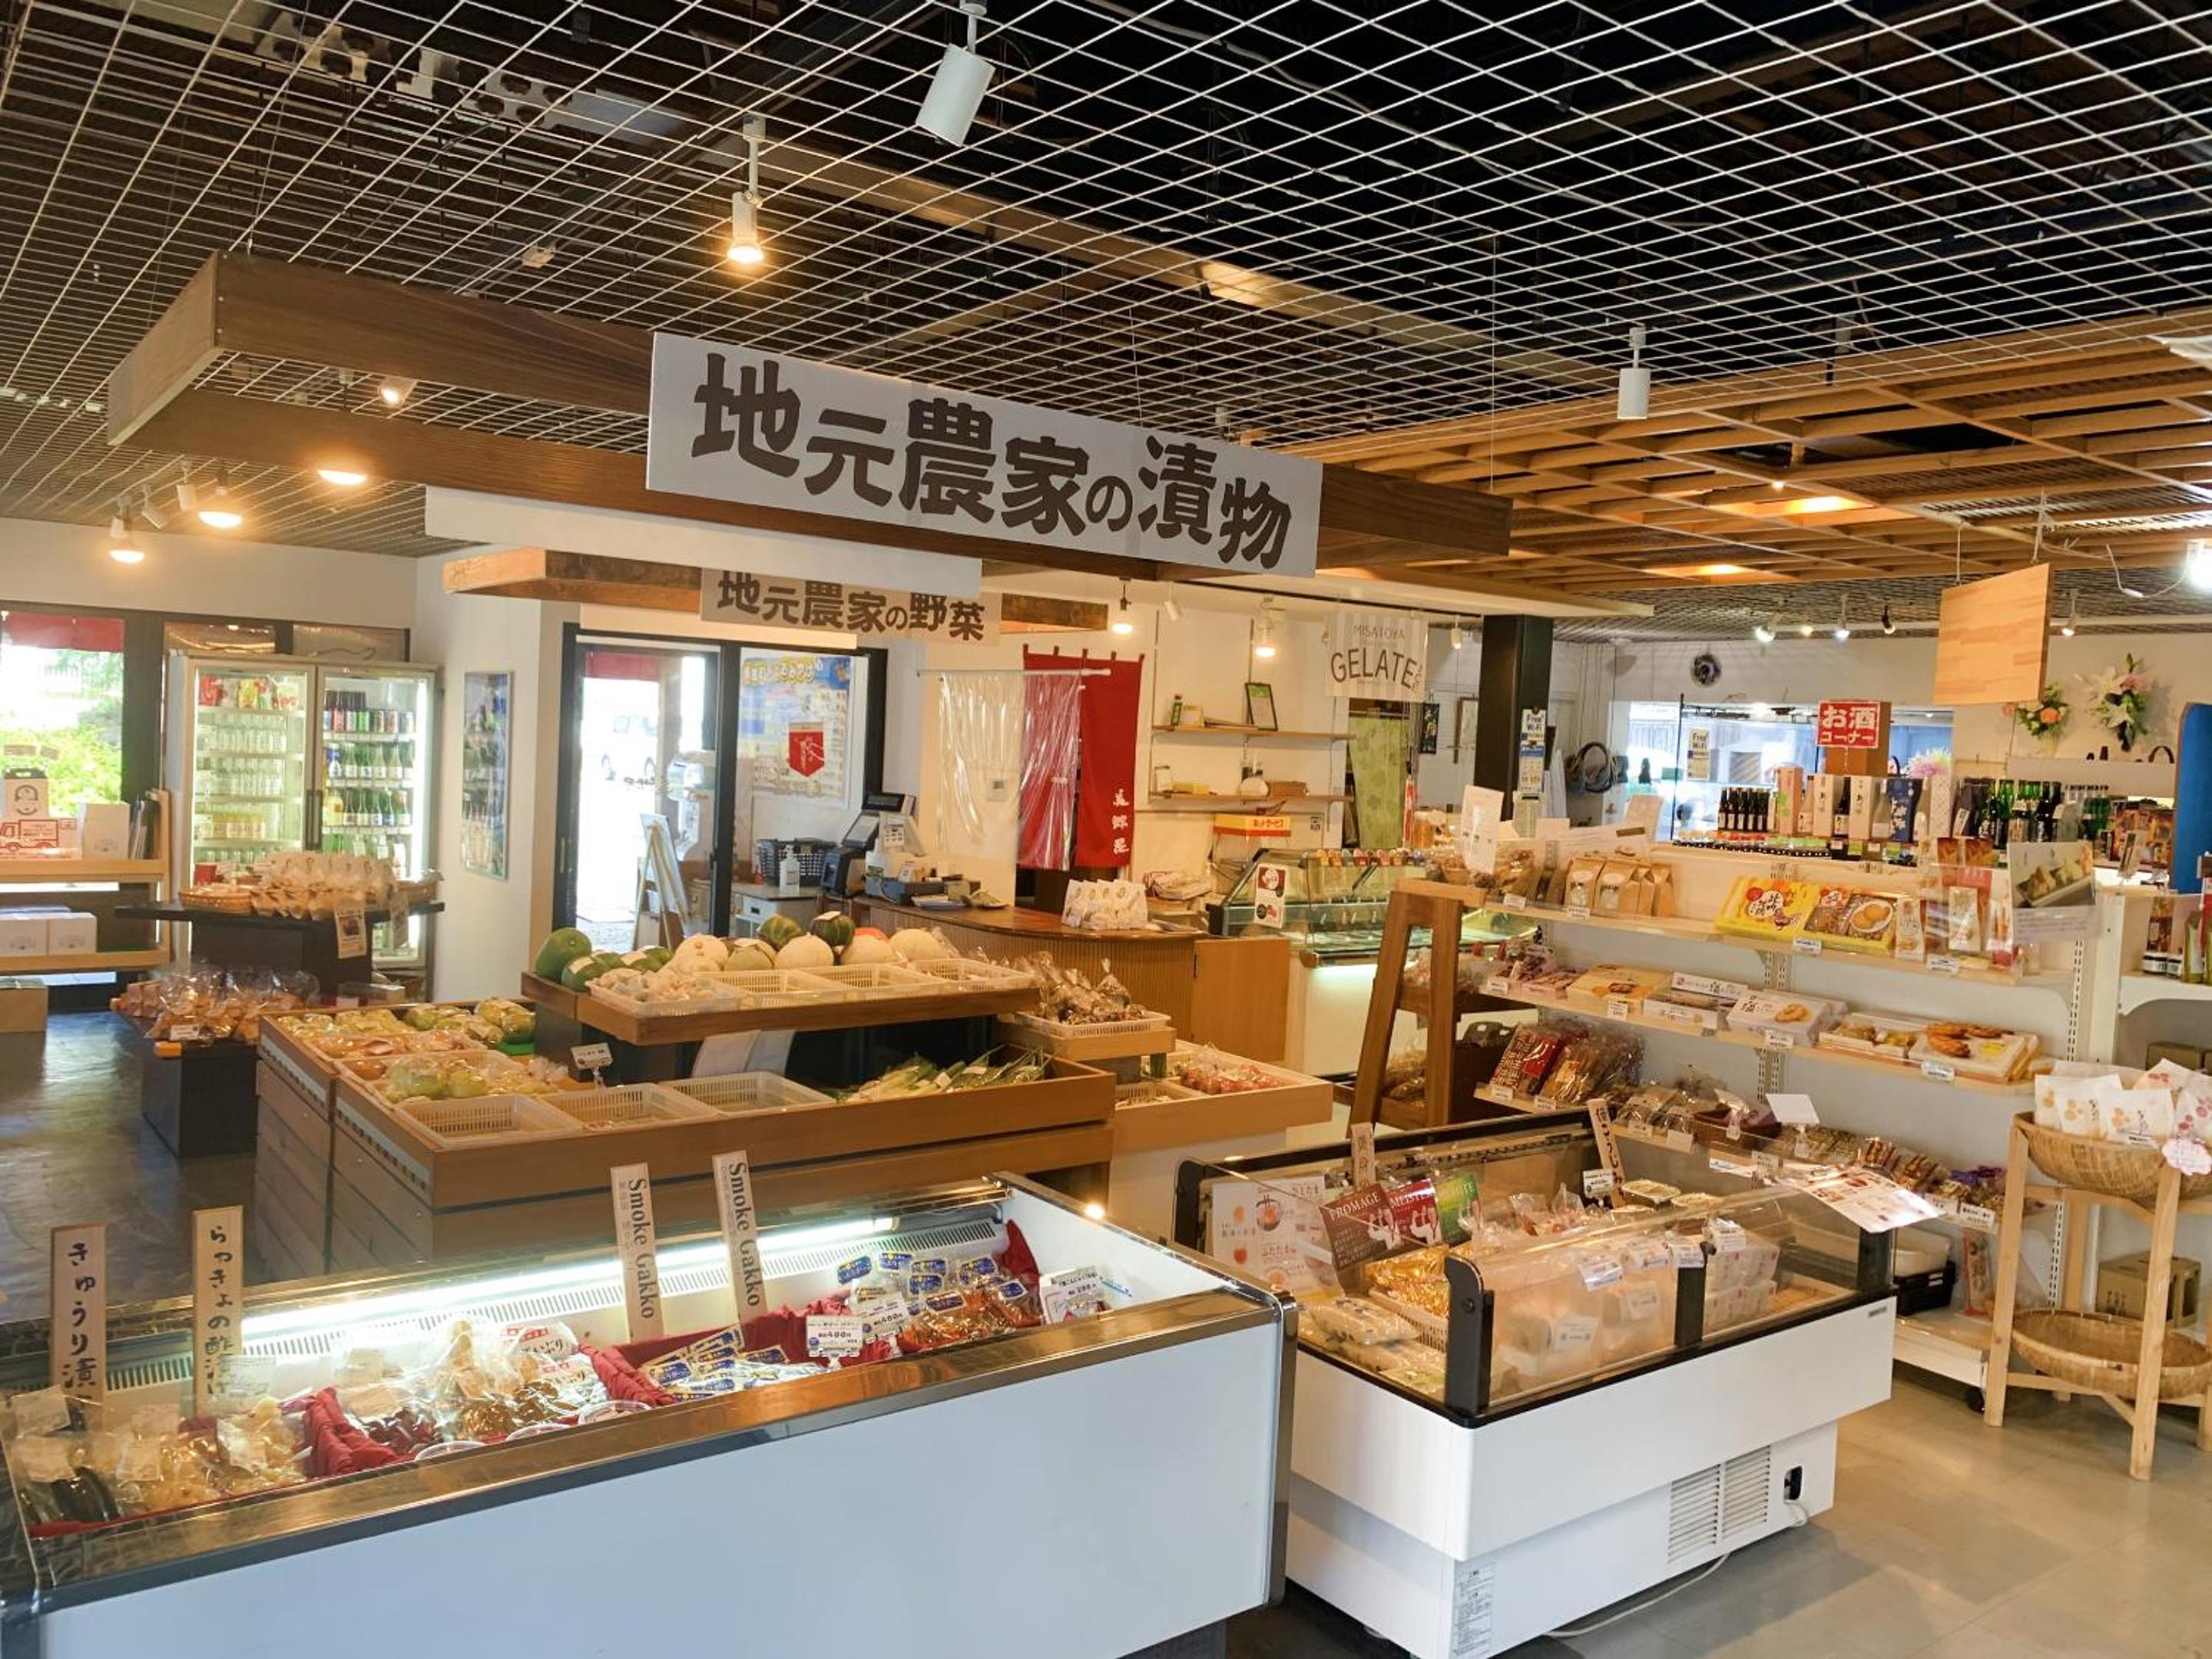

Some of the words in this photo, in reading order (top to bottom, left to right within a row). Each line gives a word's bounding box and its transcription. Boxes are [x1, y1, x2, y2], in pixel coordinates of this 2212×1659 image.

[690, 353, 1292, 571] 地元農家の漬物
[717, 570, 985, 641] 地元農家の野菜
[1820, 730, 1874, 744] コーナー
[1822, 704, 1876, 730] お酒
[628, 1178, 651, 1246] Smoke
[730, 1162, 752, 1231] Smoke
[1330, 1192, 1382, 1220] FROMAGE
[636, 1253, 659, 1319] Gakko
[739, 1240, 763, 1306] Gakko
